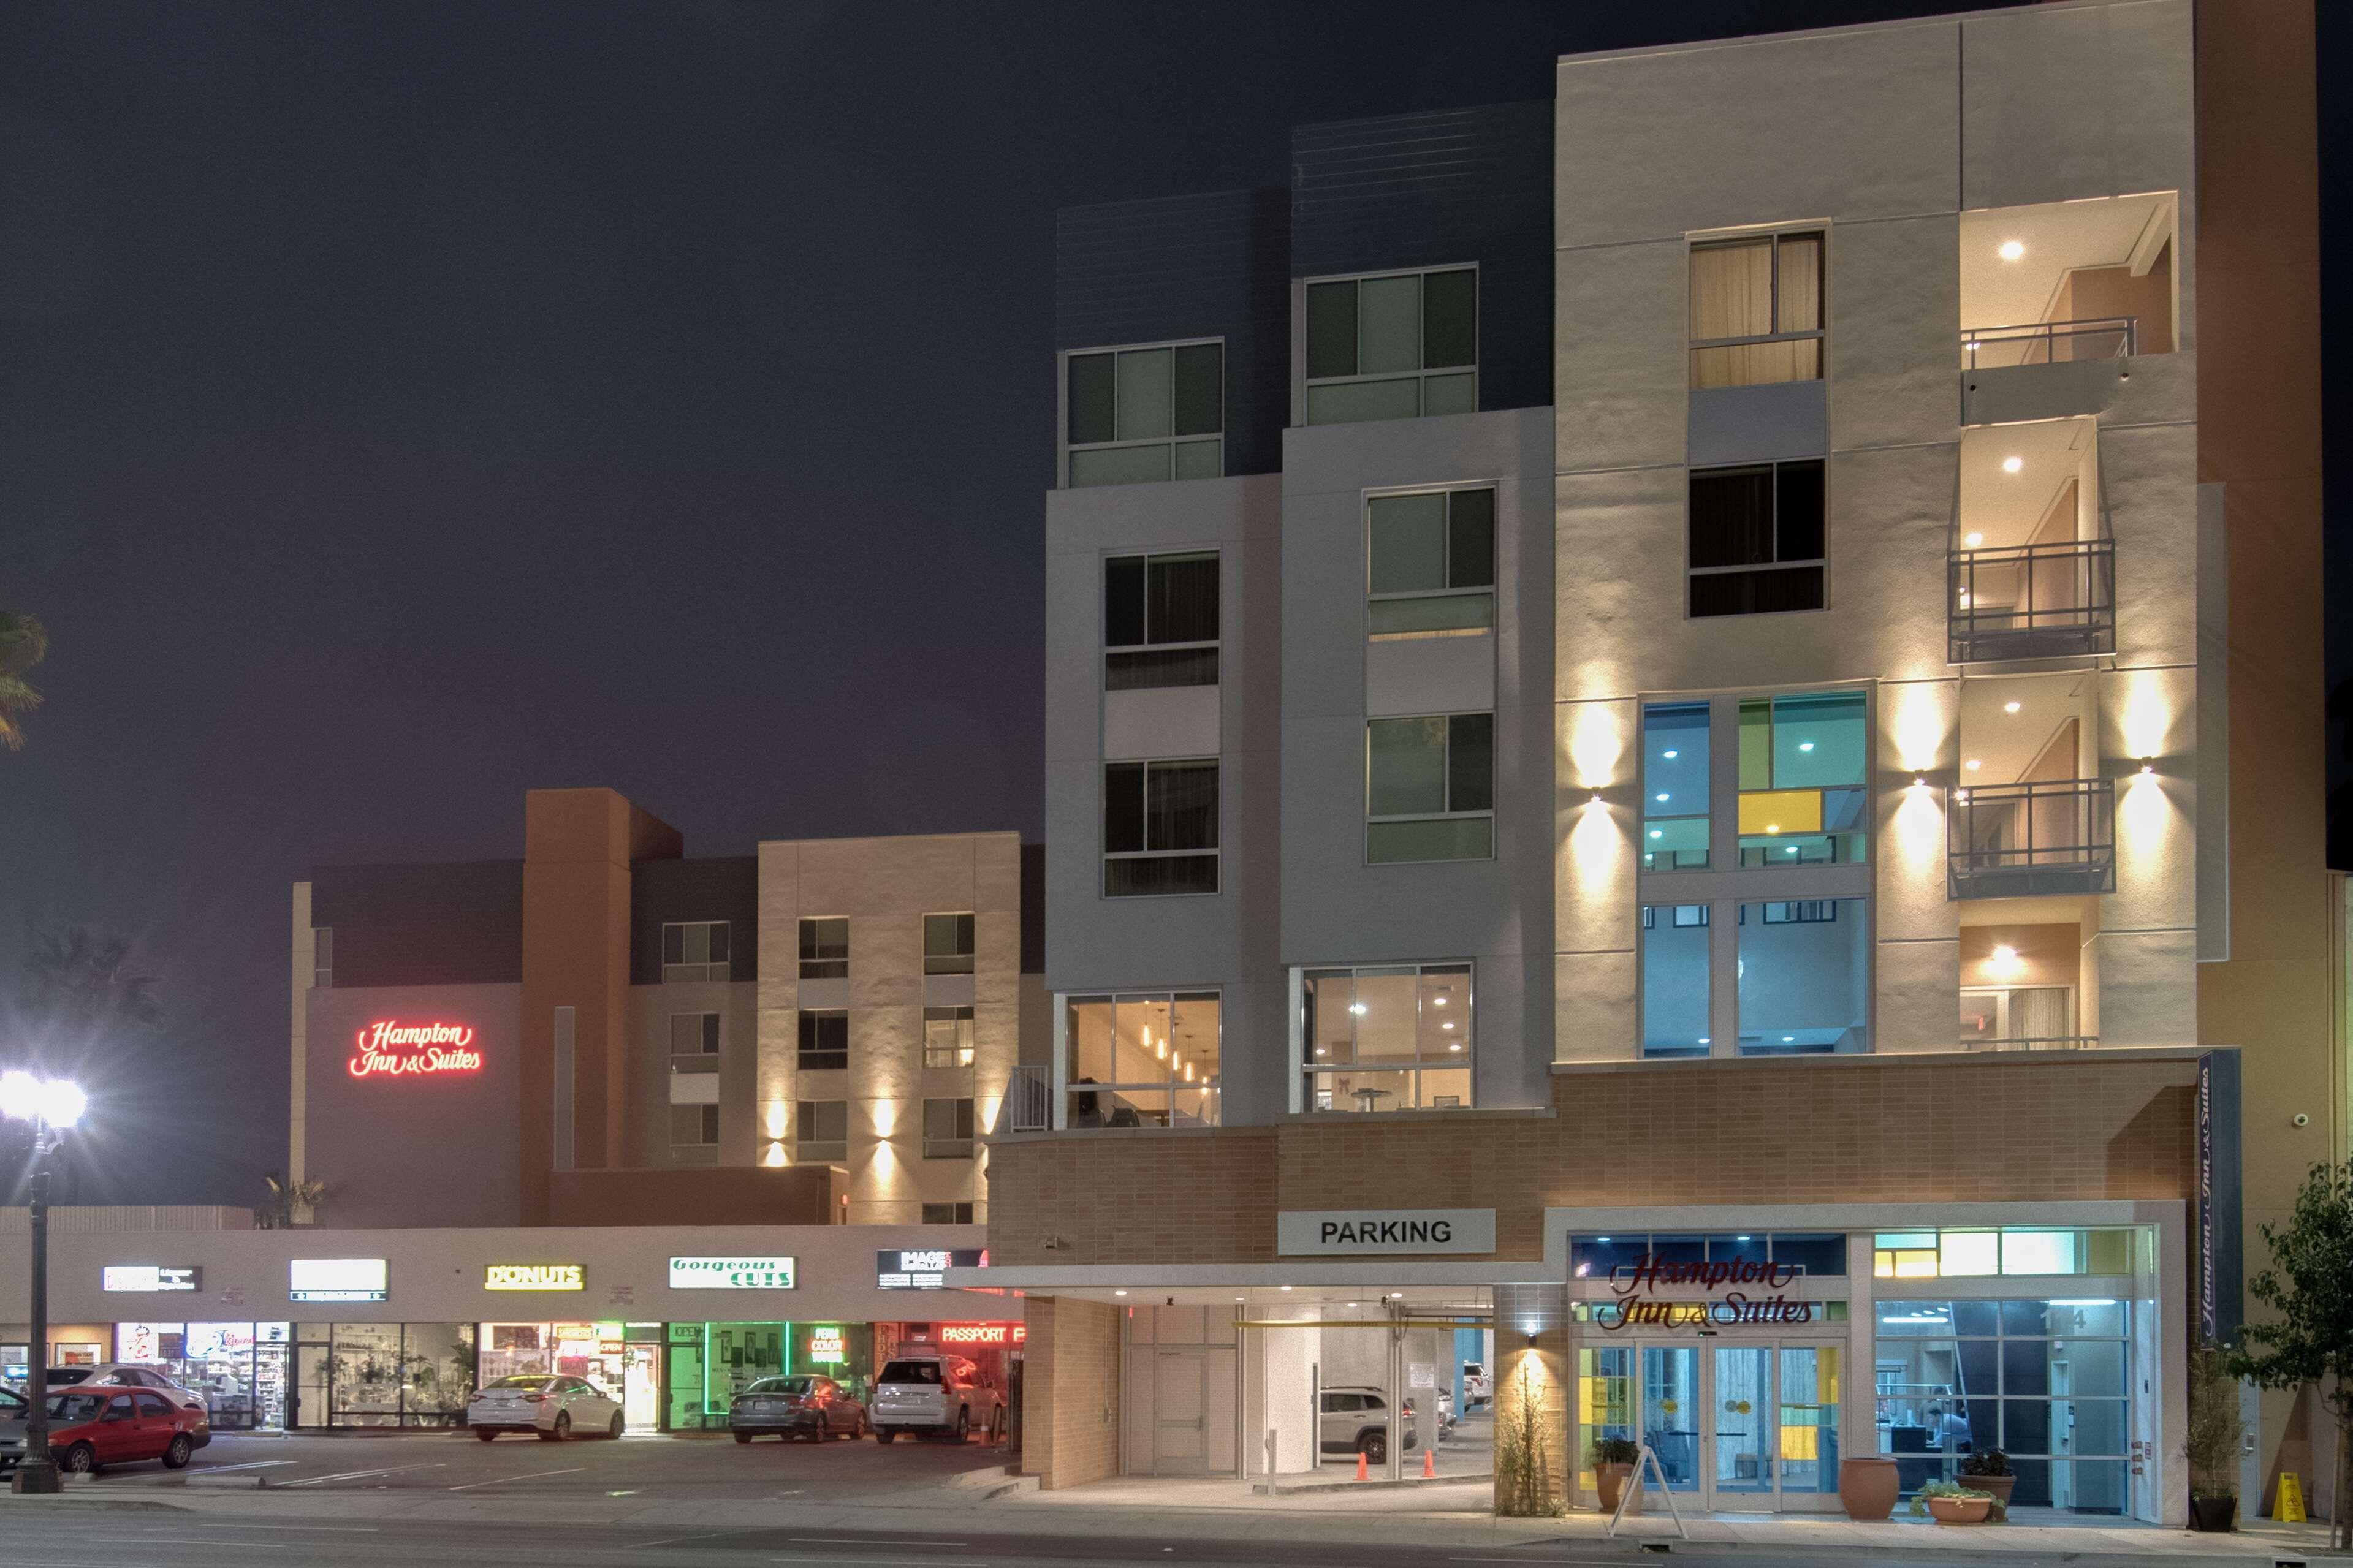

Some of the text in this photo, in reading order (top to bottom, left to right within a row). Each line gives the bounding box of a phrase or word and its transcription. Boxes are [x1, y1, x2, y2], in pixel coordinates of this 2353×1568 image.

[359, 1020, 472, 1051] Hampton
[350, 1047, 481, 1076] Inn & Suites
[2200, 1067, 2213, 1338] Hampton Inn & Suites
[1321, 1220, 1451, 1243] PARKING
[673, 1259, 775, 1271] Gorgeous
[901, 1251, 946, 1263] IMAGE
[487, 1265, 581, 1284] DONUTS
[730, 1272, 790, 1286] CUTS
[1609, 1251, 1795, 1295] Hampton
[1597, 1292, 1812, 1330] Inn & Suites
[942, 1327, 1006, 1342] PASSPORT
